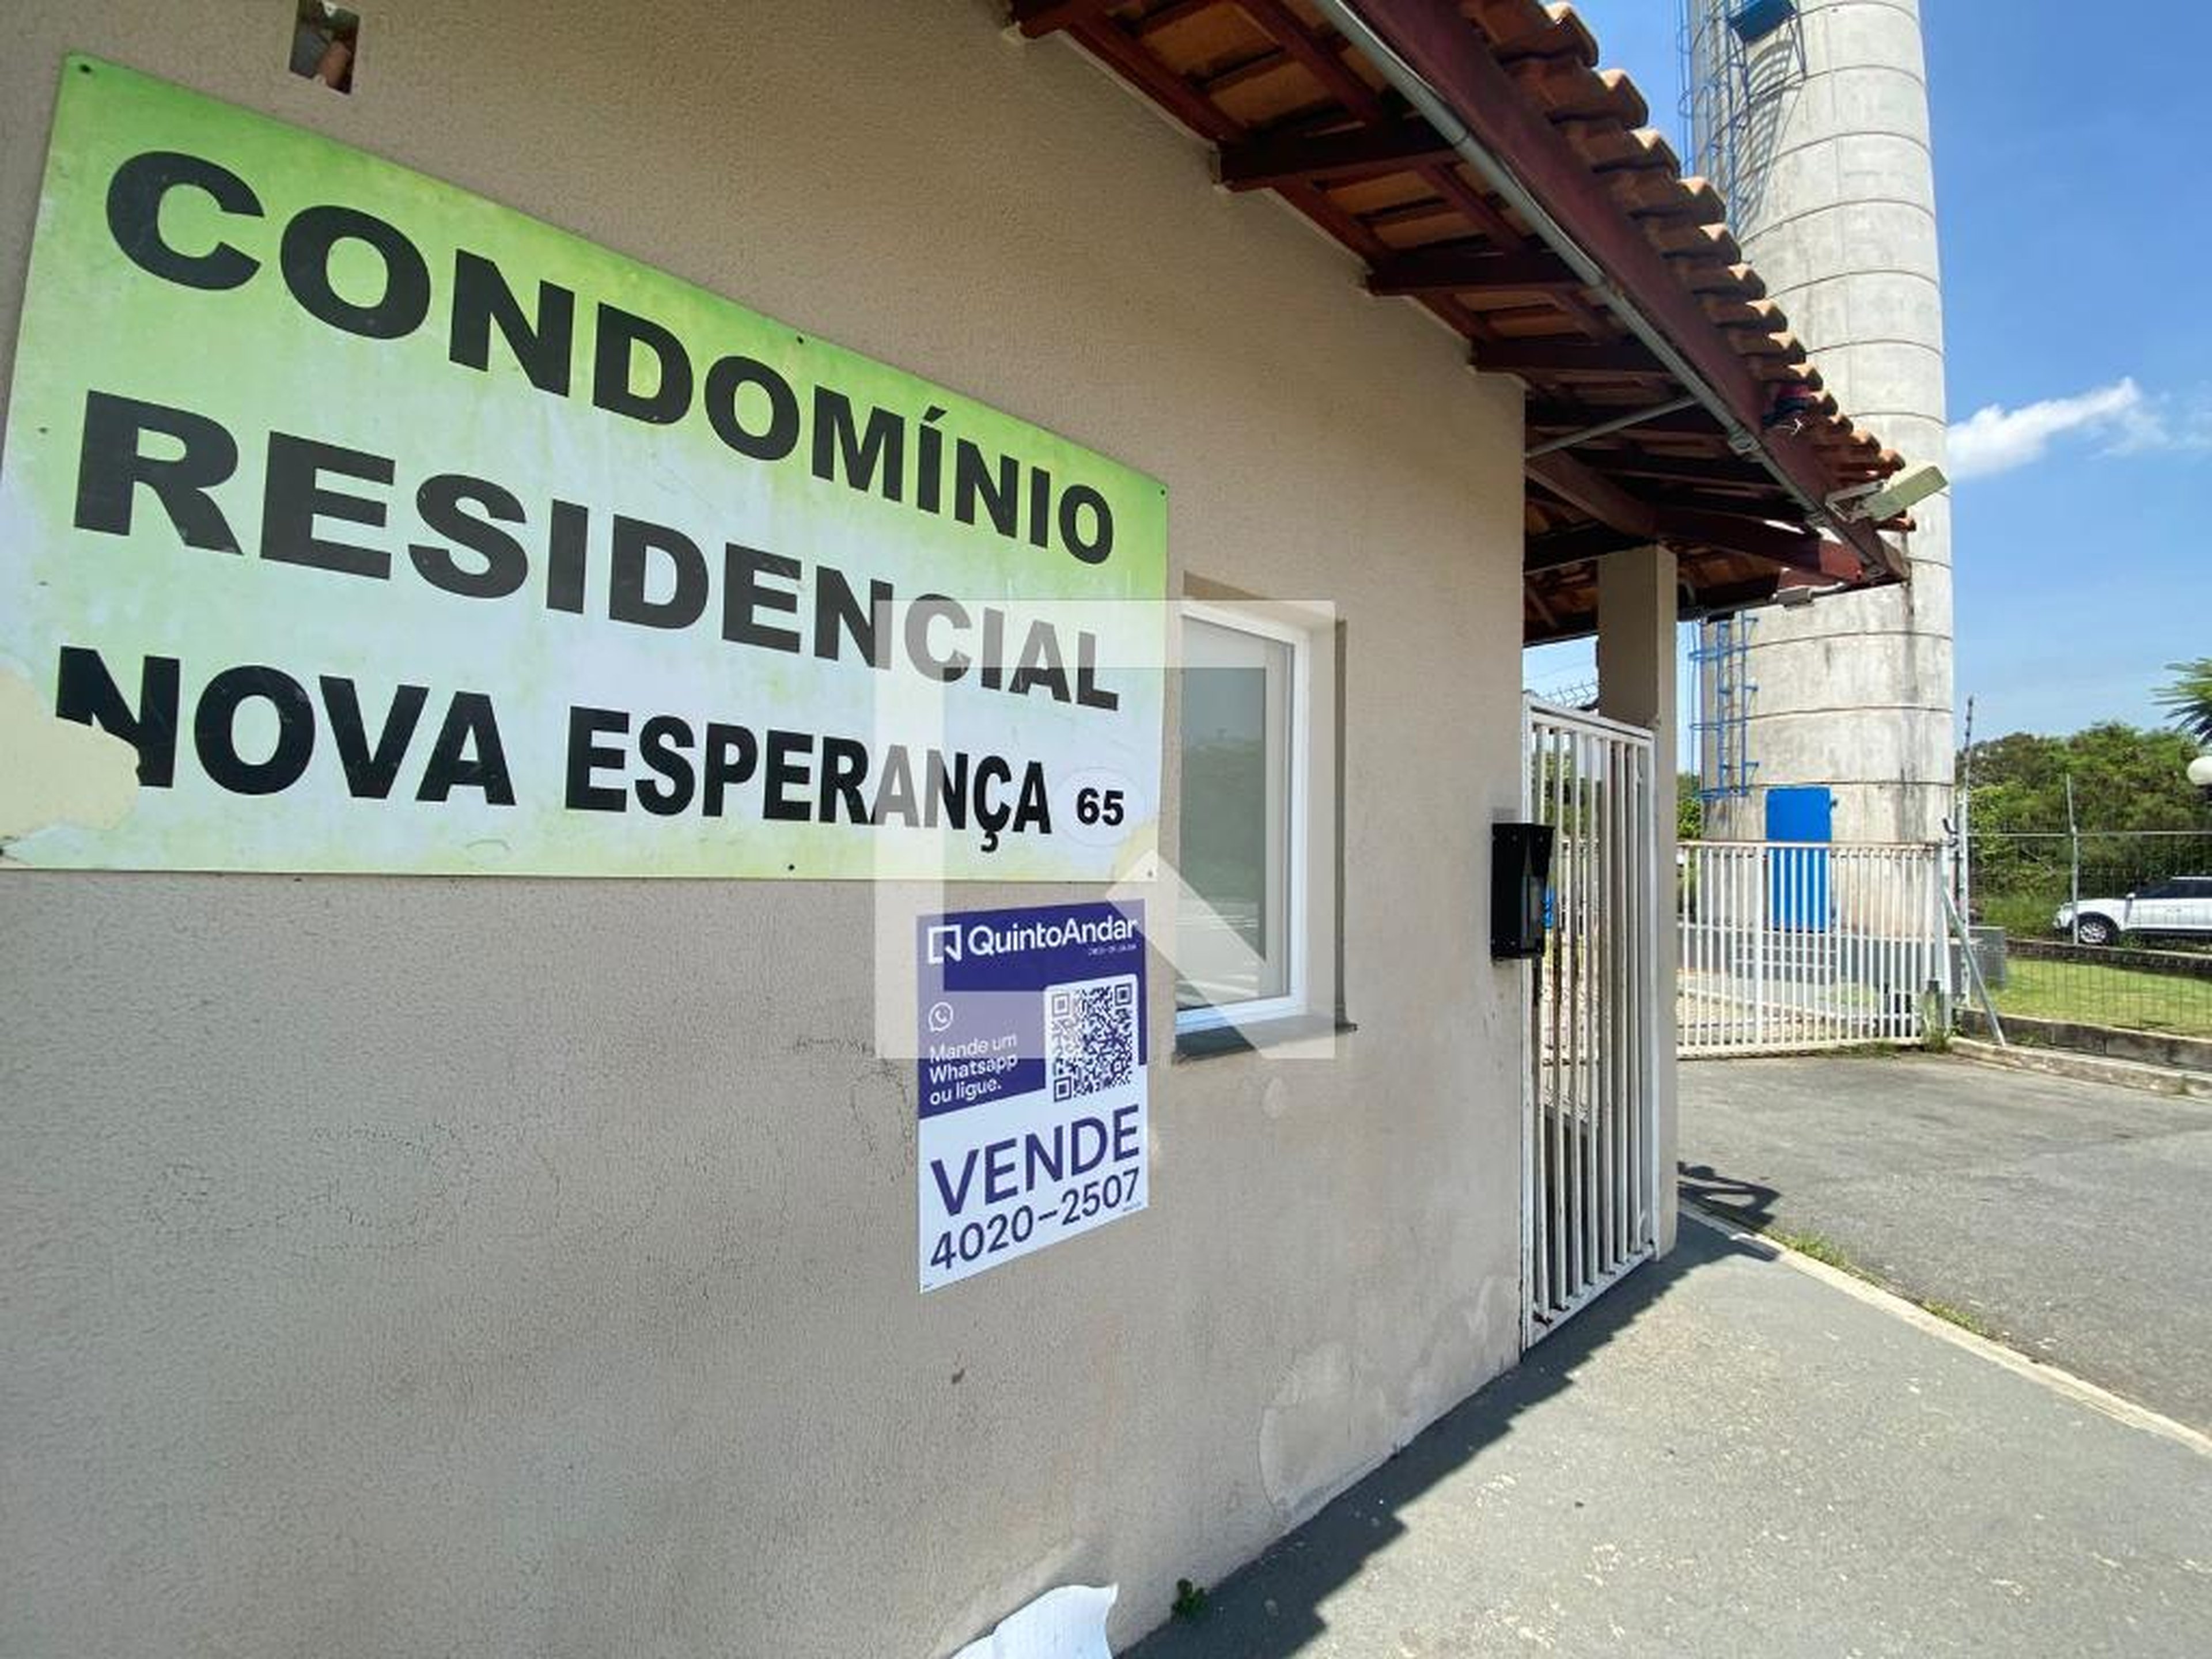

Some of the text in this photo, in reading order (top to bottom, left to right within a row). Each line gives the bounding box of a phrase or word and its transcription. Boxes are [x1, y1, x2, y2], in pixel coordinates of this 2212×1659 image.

[106, 150, 1113, 565] CONDOMÍNIO
[74, 389, 1119, 711] RESIDENCIAL
[55, 645, 1052, 853] NOVA ESPERANÇA
[1075, 786, 1124, 828] 65
[967, 914, 1139, 956] QuintoAndar
[929, 1033, 1018, 1064] Mande um
[929, 1054, 1019, 1085] Whatsapp
[929, 1078, 1002, 1106] ou ligue.
[930, 1104, 1140, 1217] VENDE
[930, 1166, 1140, 1270] 4020-2507
